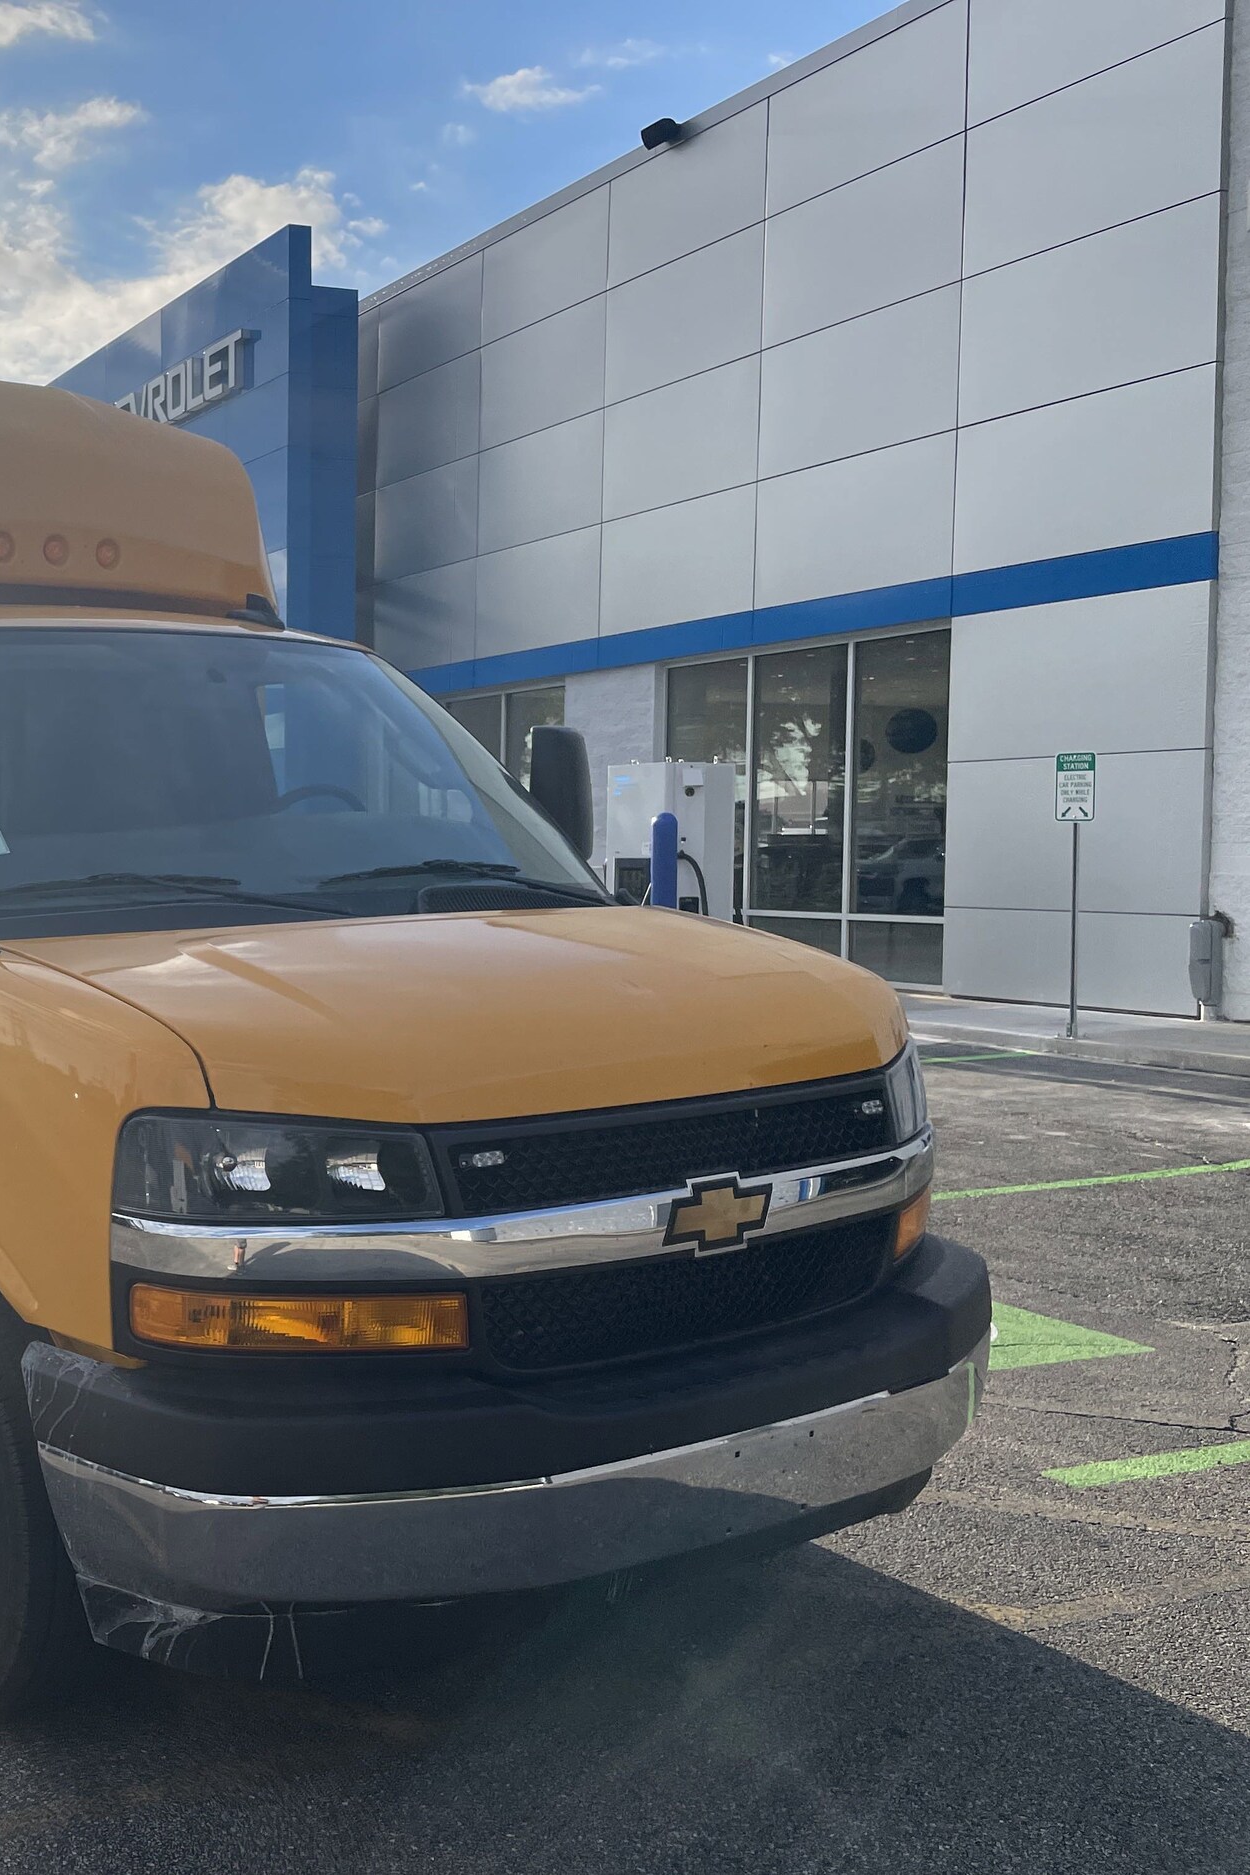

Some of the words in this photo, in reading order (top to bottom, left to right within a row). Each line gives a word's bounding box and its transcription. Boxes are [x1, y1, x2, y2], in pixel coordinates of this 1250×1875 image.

[114, 328, 255, 424] VROLET
[1060, 754, 1092, 762] CHARGING
[1063, 762, 1089, 770] STATION
